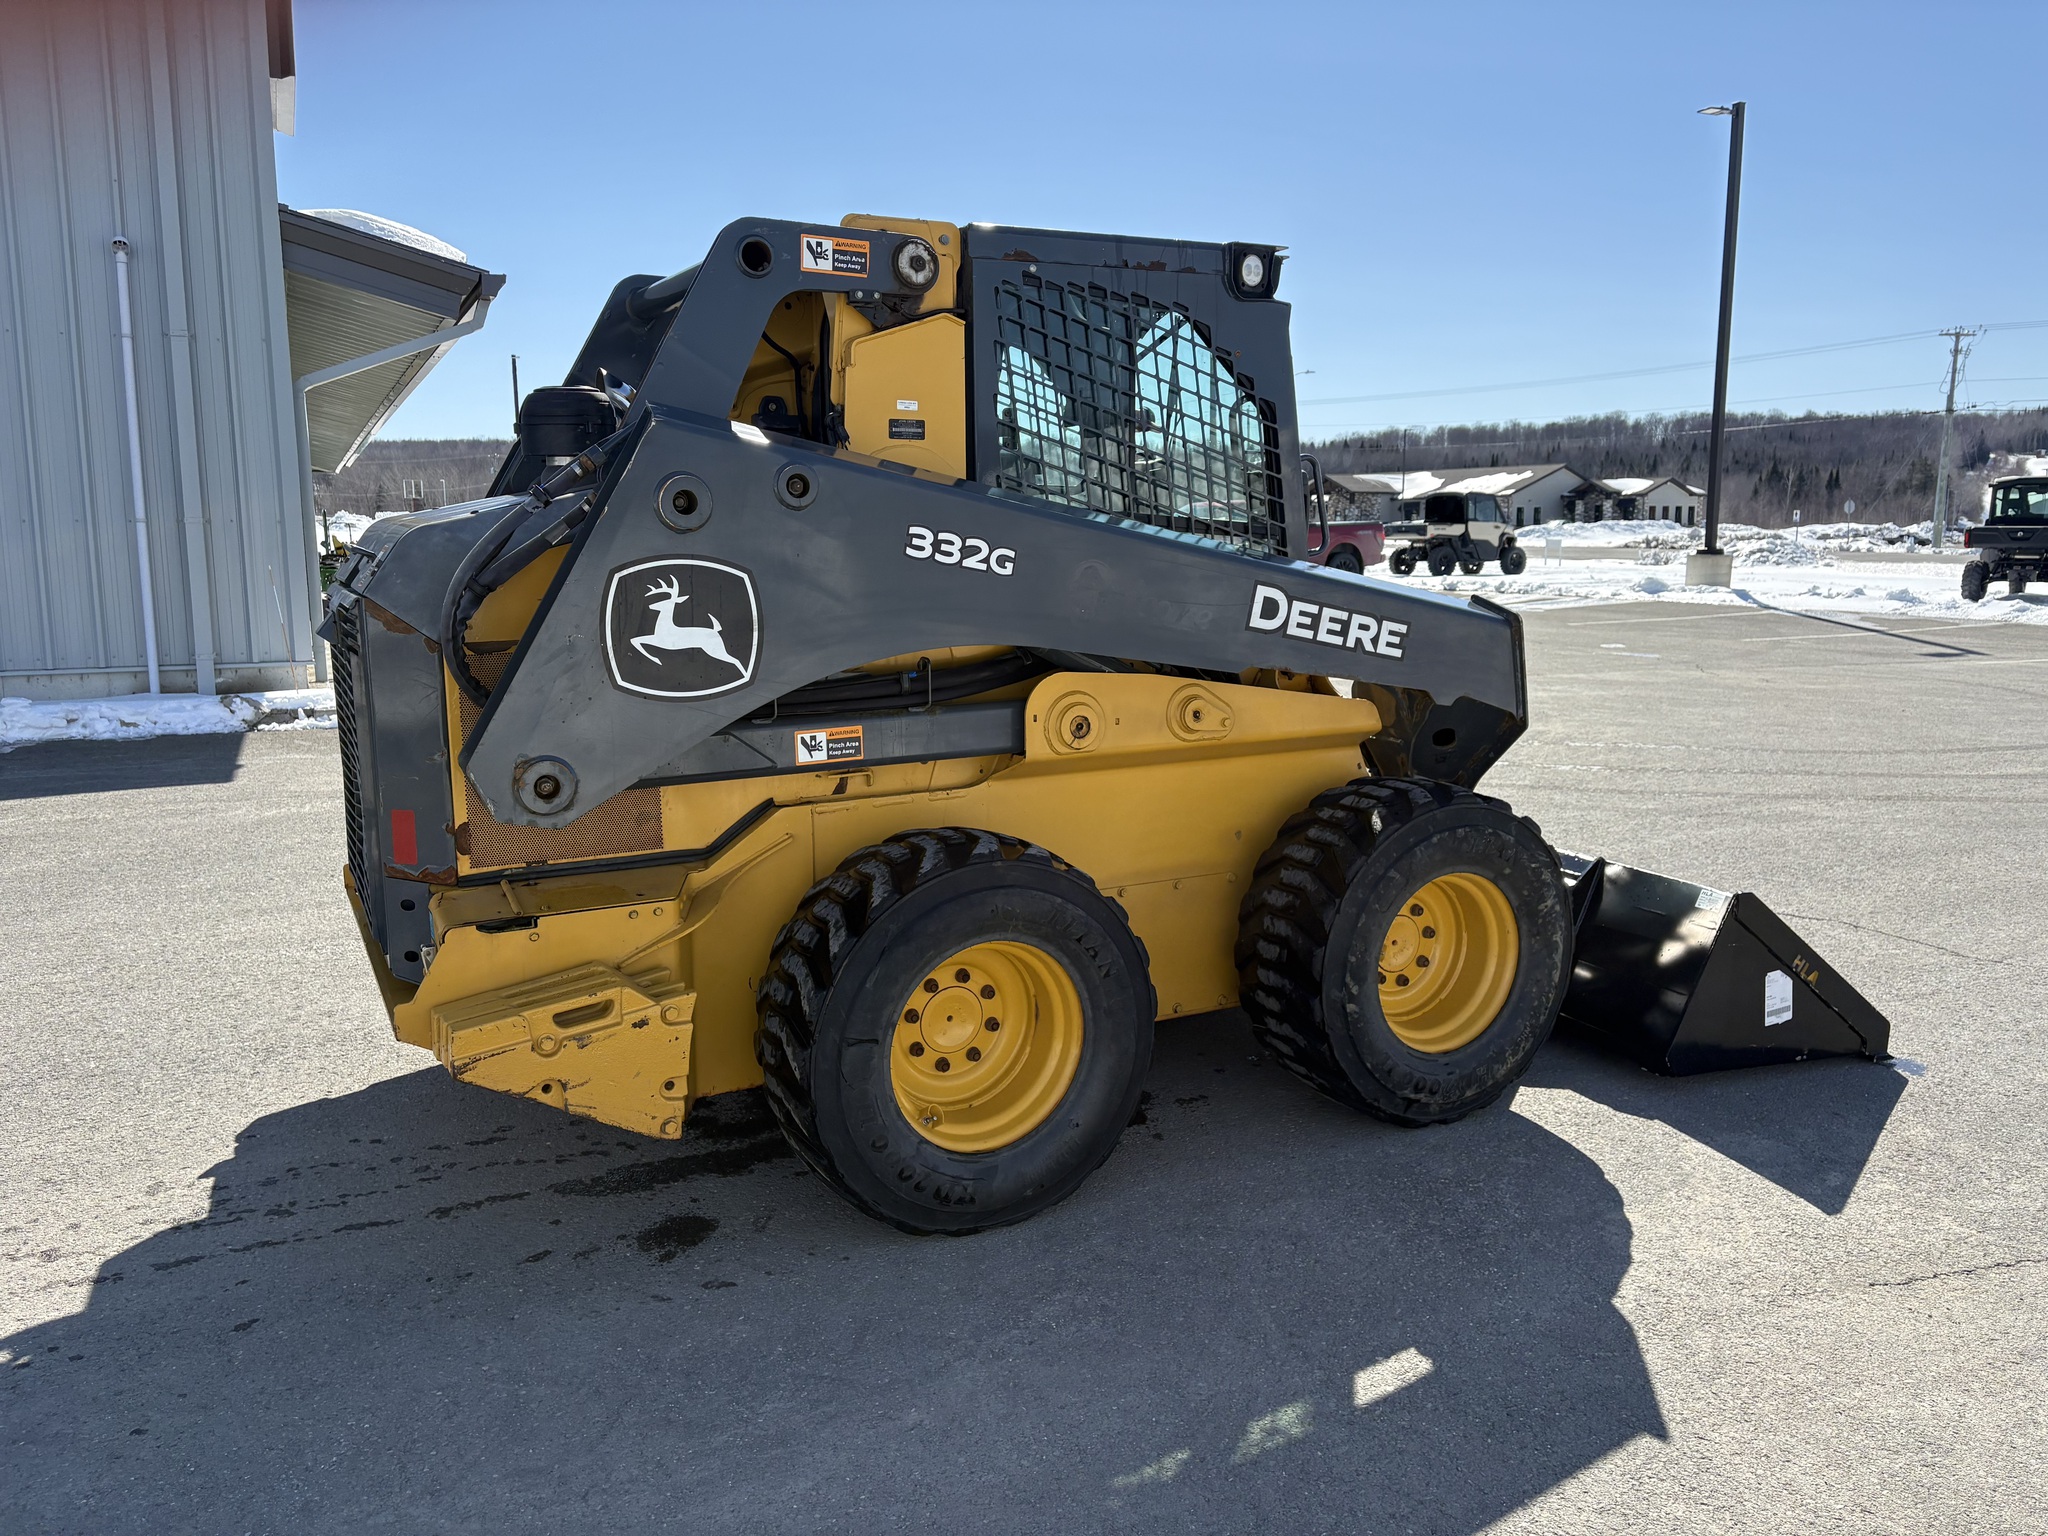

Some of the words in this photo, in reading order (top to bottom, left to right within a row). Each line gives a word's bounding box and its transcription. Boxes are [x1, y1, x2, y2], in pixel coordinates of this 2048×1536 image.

[834, 253, 851, 261] Pinch
[851, 255, 865, 263] Area
[834, 261, 847, 269] Keep
[905, 526, 1016, 576] 332G
[1249, 584, 1408, 658] DEERE
[1792, 954, 1819, 986] HLA
